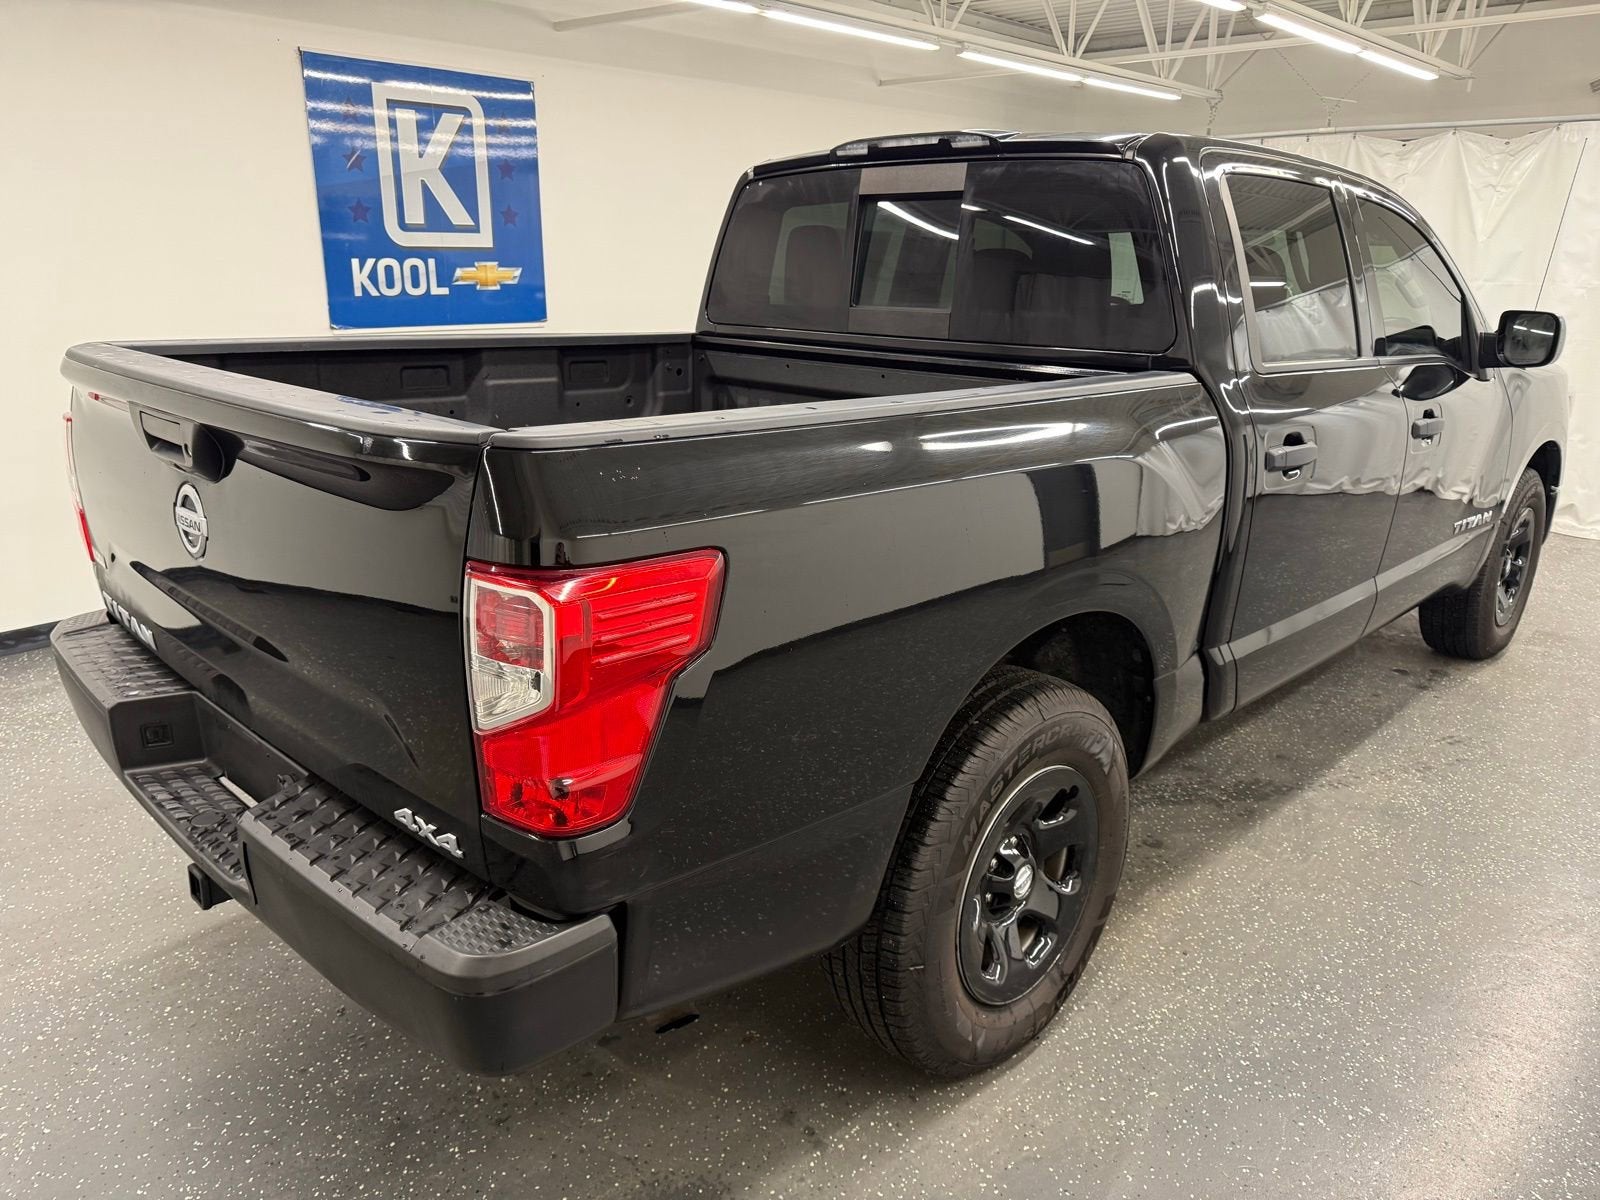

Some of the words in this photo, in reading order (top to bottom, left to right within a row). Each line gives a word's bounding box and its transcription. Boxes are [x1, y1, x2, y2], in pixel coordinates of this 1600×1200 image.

[395, 107, 476, 226] K
[350, 257, 450, 297] KOOL
[1453, 510, 1493, 535] TITAN
